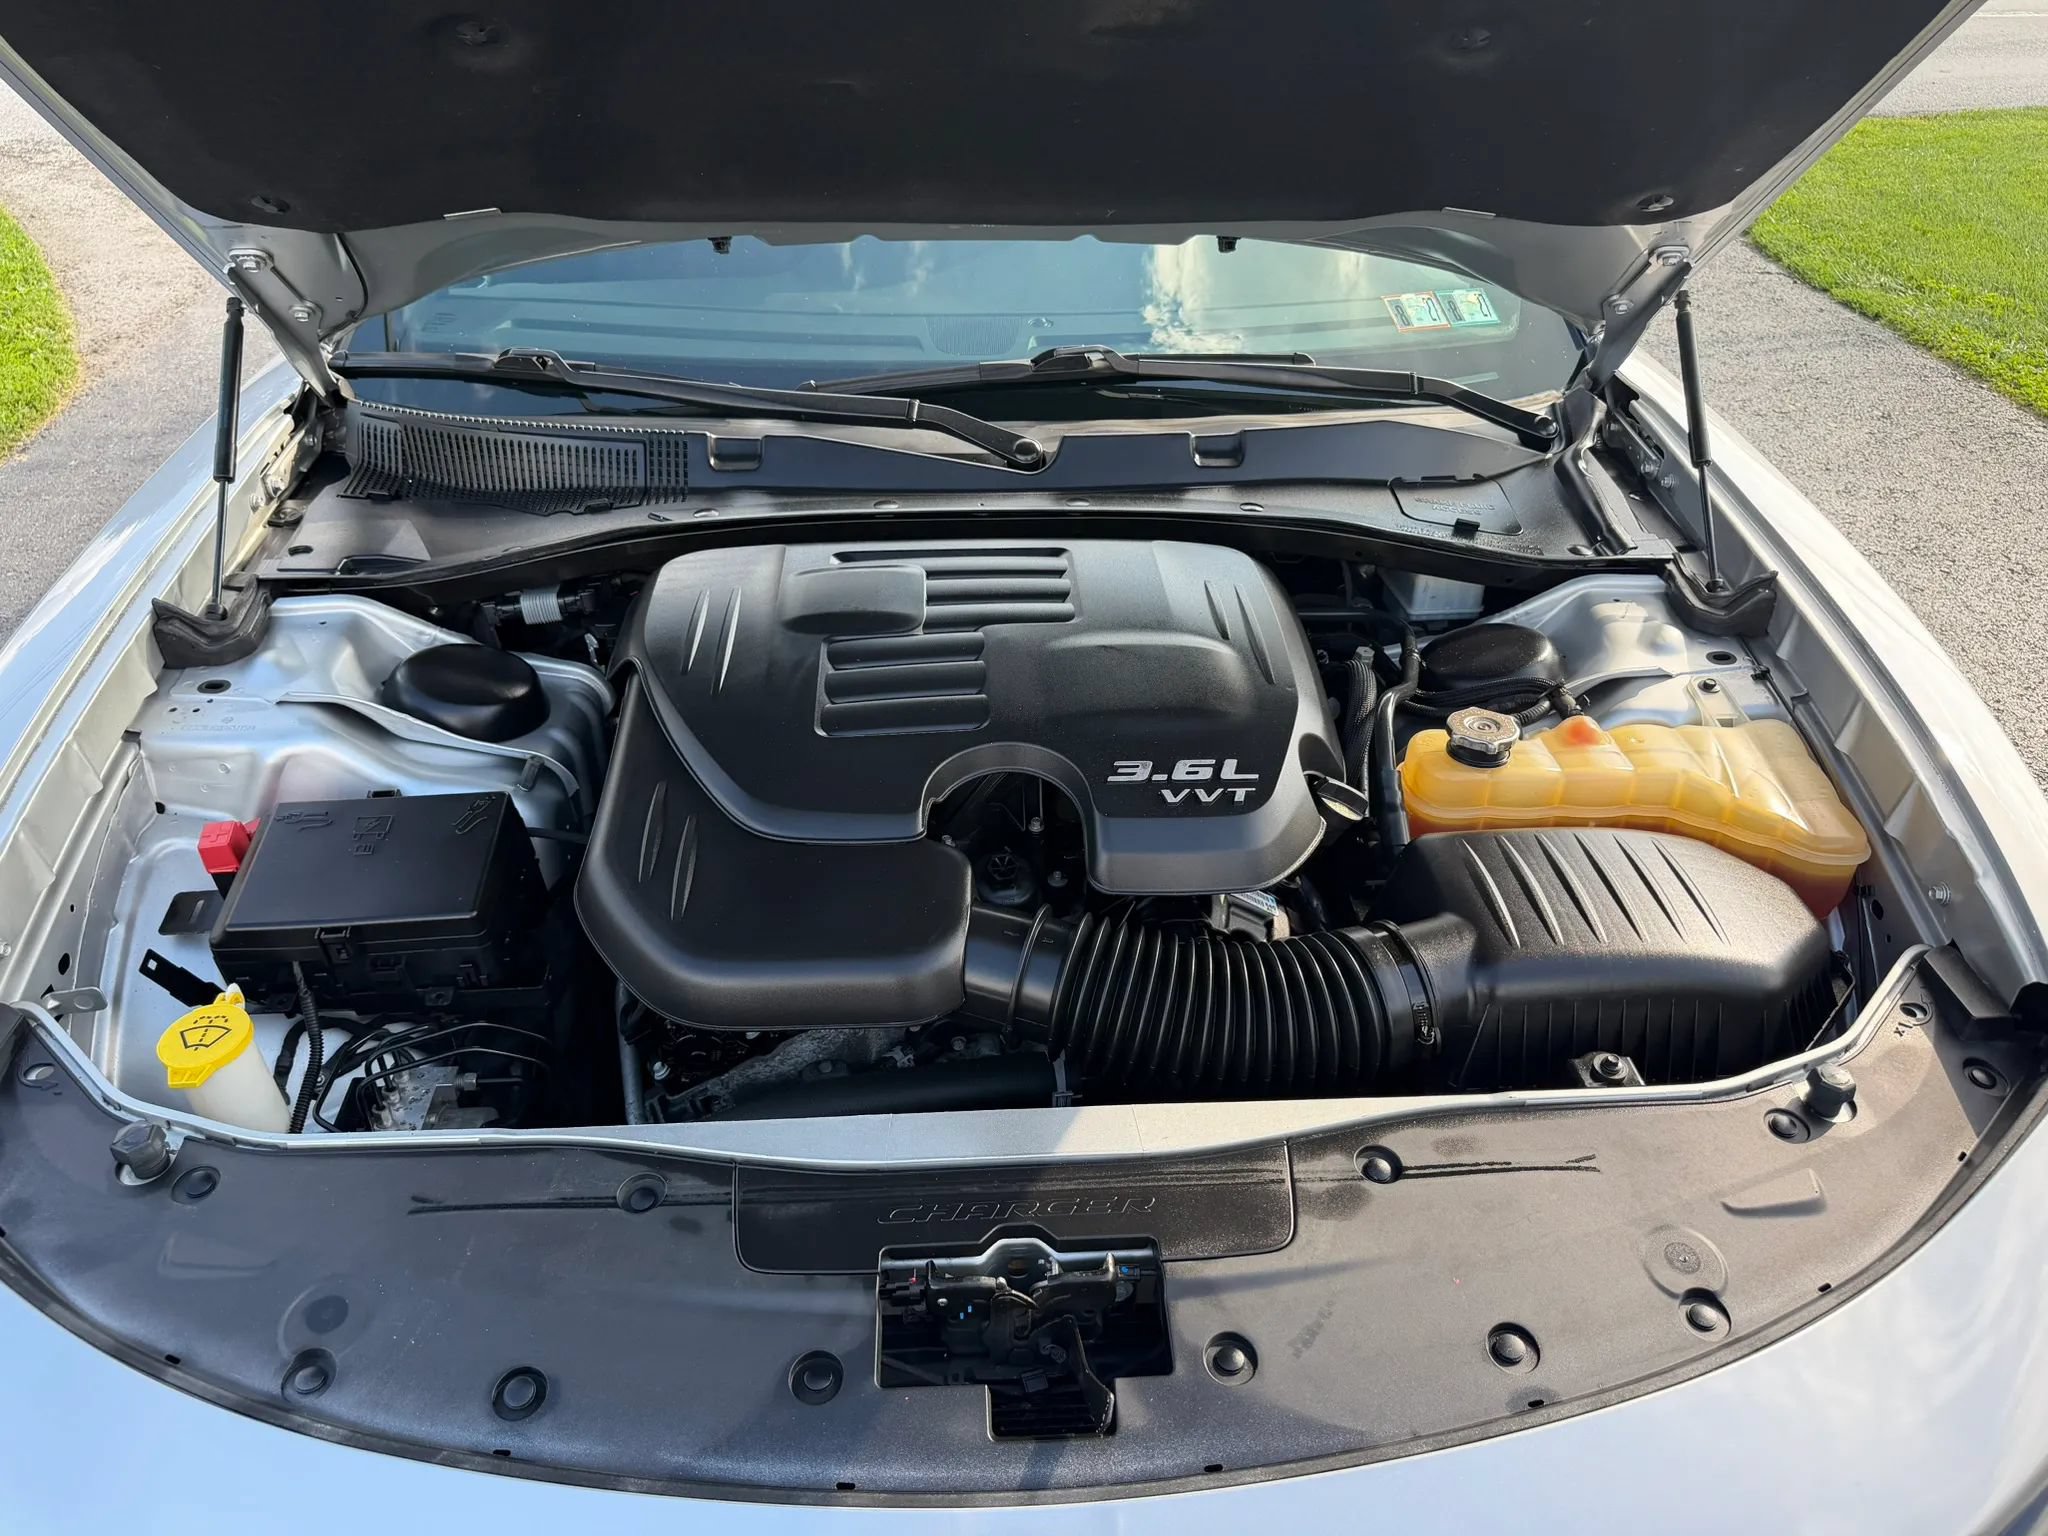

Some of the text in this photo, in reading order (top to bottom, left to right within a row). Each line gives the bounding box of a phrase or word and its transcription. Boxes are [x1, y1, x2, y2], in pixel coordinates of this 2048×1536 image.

[1107, 758, 1259, 782] 3.6L
[1160, 787, 1256, 804] VVT
[876, 1196, 1156, 1224] CHARGER
